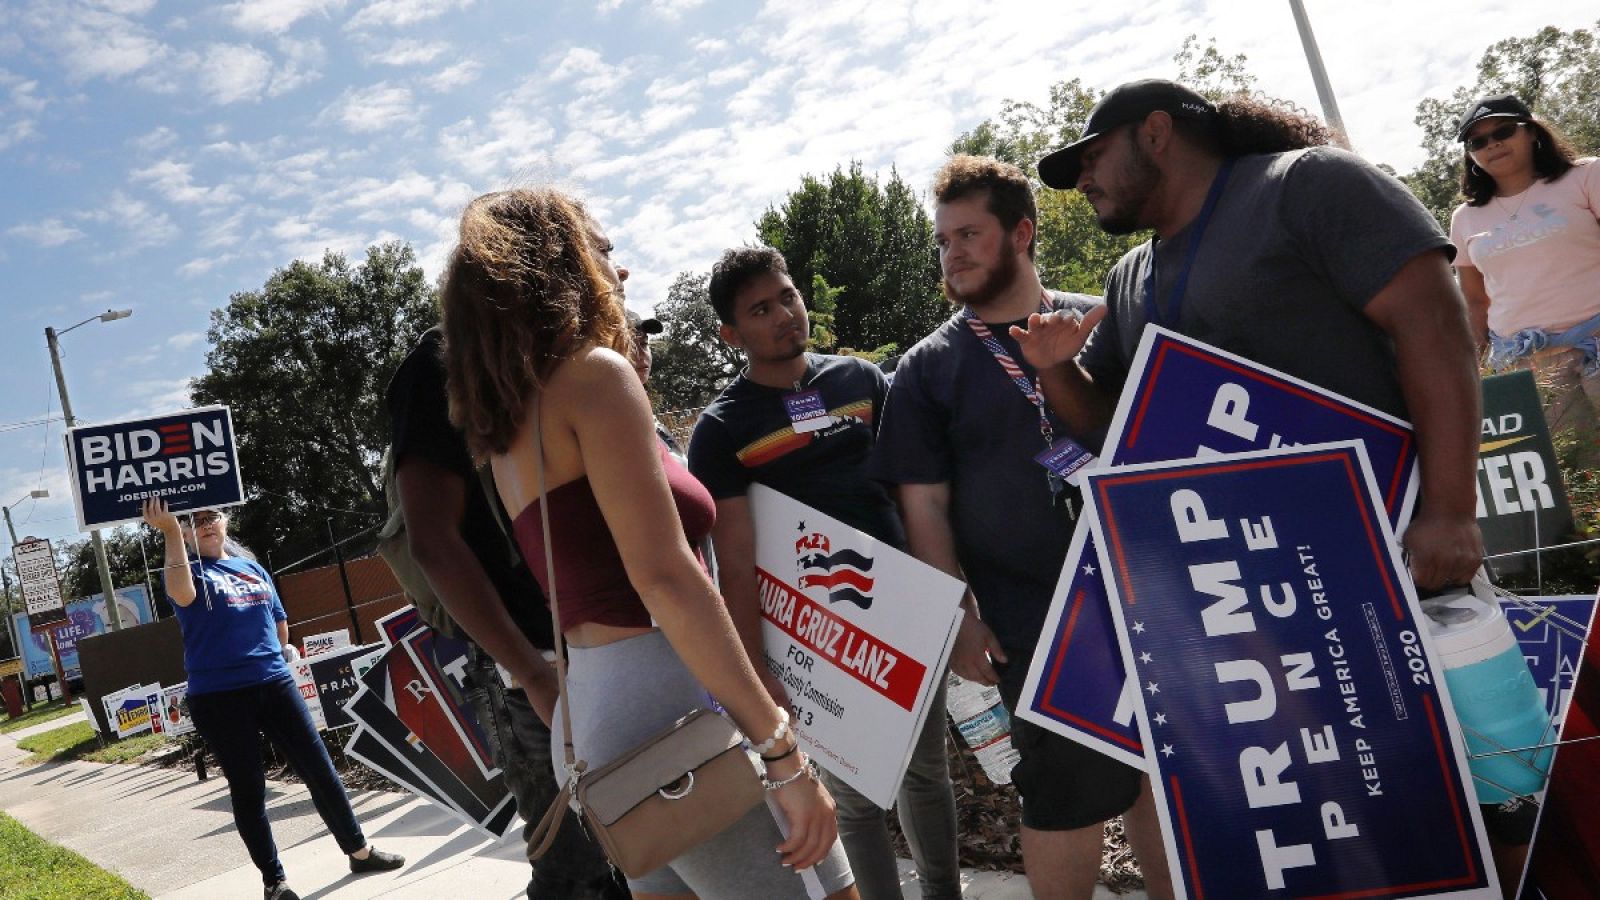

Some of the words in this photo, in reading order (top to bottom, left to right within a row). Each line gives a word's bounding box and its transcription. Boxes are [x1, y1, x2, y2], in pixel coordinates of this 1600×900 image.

[80, 419, 225, 466] BIDEN
[1480, 412, 1522, 436] AD
[85, 451, 230, 493] HARRIS
[117, 482, 206, 502] JOEBIDEN.COM
[1475, 451, 1555, 518] TER
[1296, 544, 1333, 620] GREAT!
[757, 574, 797, 628] AURA
[796, 605, 845, 658] CRUZ
[840, 632, 898, 690] LANZ
[786, 643, 815, 673] FOR
[1399, 630, 1432, 686] 2020
[803, 680, 845, 719] Commission
[1170, 488, 1316, 890] TRUMP
[1240, 515, 1360, 840] PENCE
[1324, 628, 1366, 729] AMERICA
[804, 711, 814, 726] 3
[1355, 738, 1384, 796] KEEP
